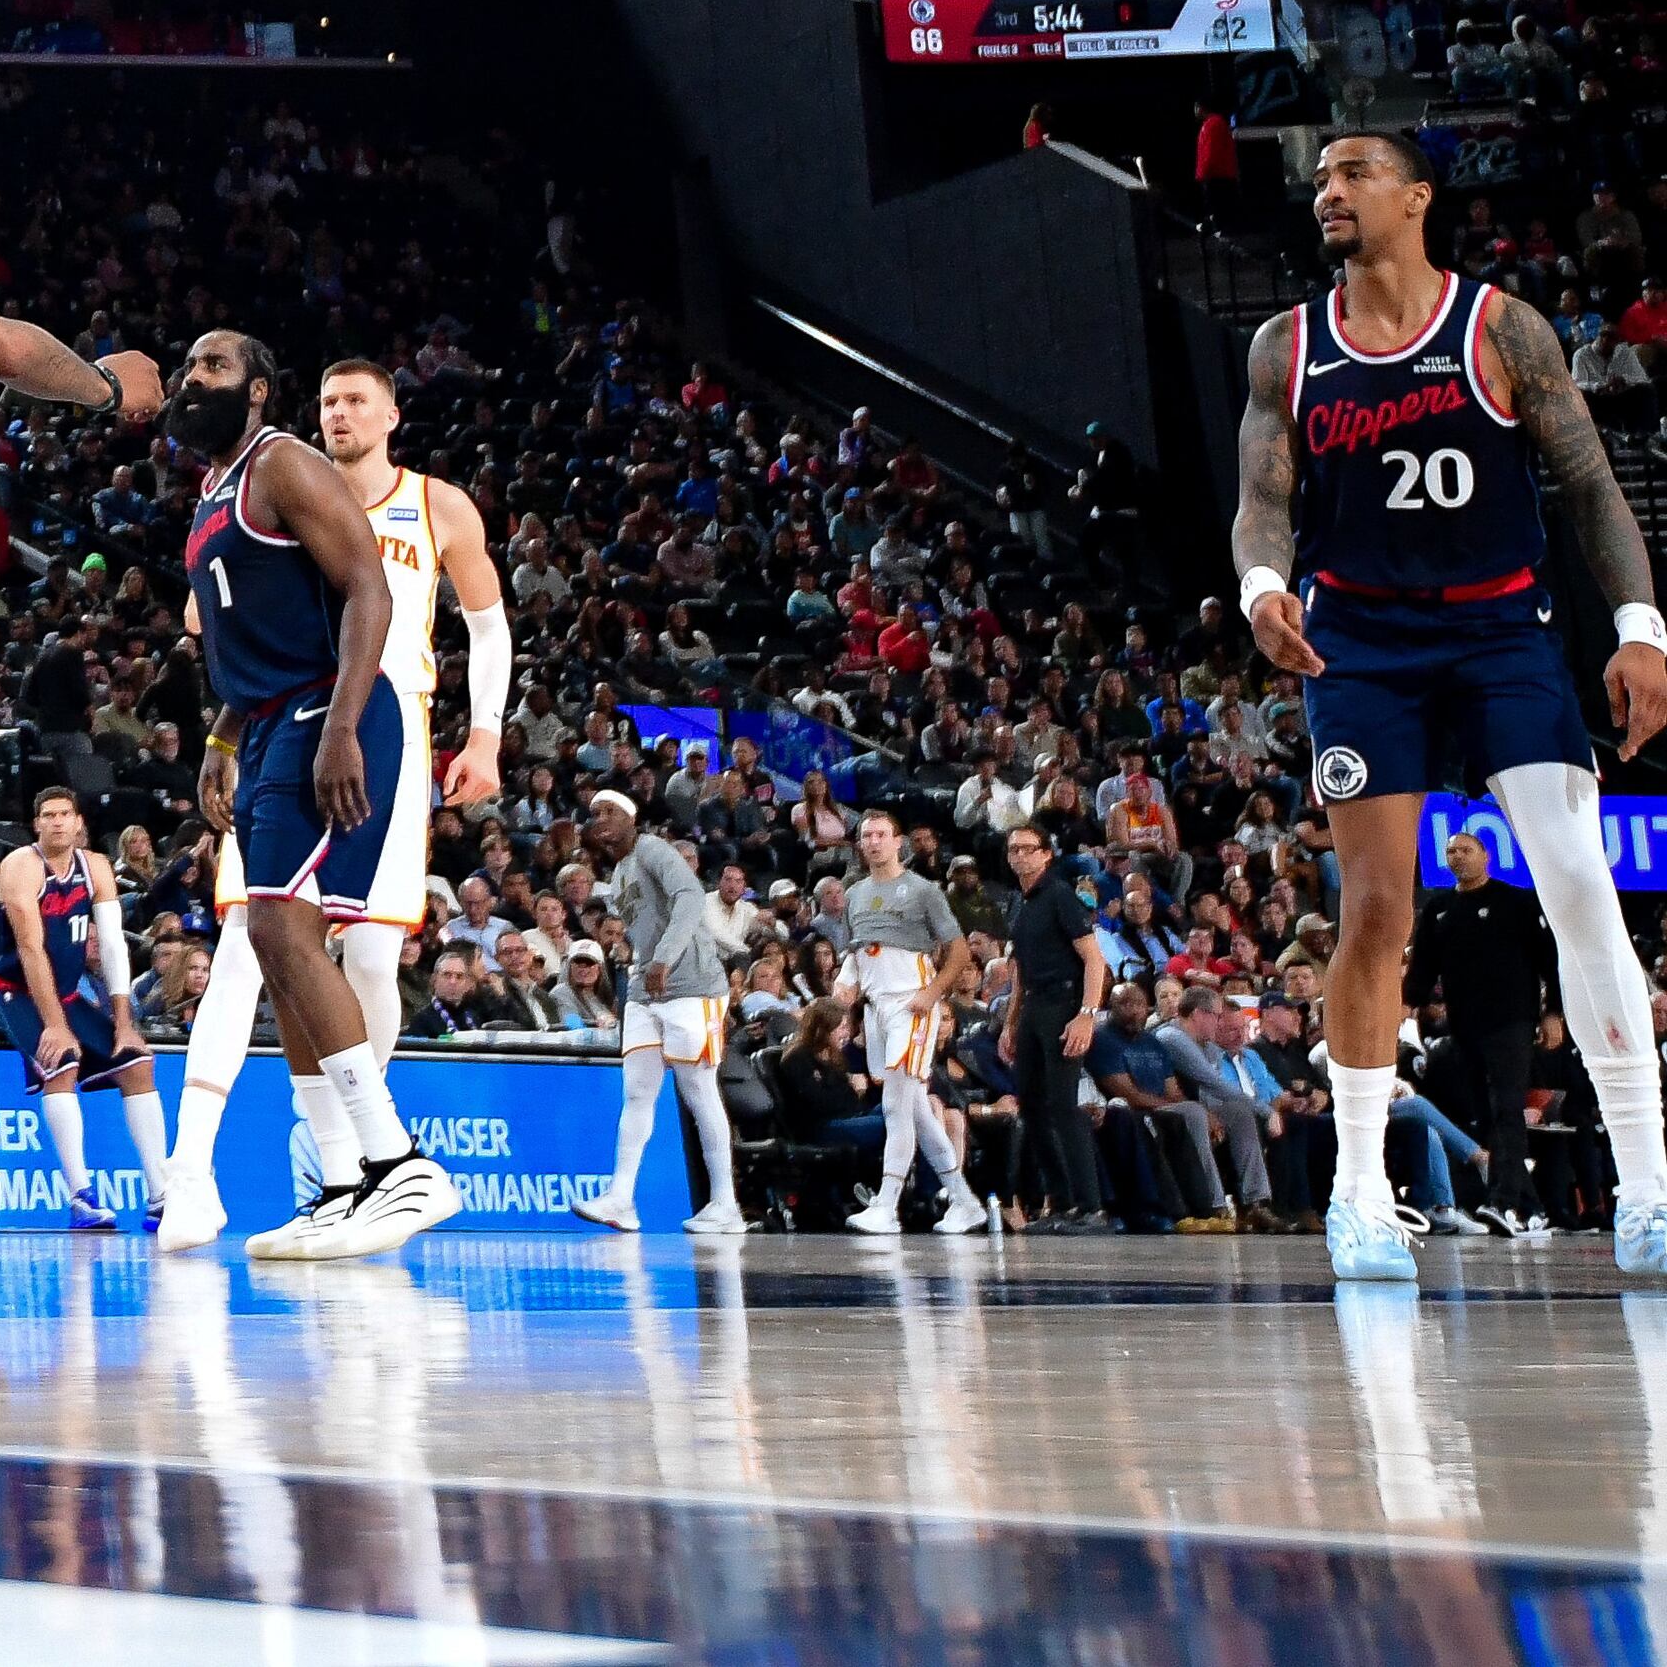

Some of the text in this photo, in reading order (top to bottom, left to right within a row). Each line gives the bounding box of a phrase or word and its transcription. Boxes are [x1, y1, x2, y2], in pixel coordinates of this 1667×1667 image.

[1033, 3, 1084, 31] 5:44
[1412, 363, 1462, 374] RWANDA
[1422, 355, 1451, 365] VISIT
[1307, 379, 1467, 455] Clippers
[1381, 447, 1475, 509] 20
[208, 555, 233, 608] 1
[68, 914, 90, 943] 11
[410, 1116, 512, 1158] KAISER
